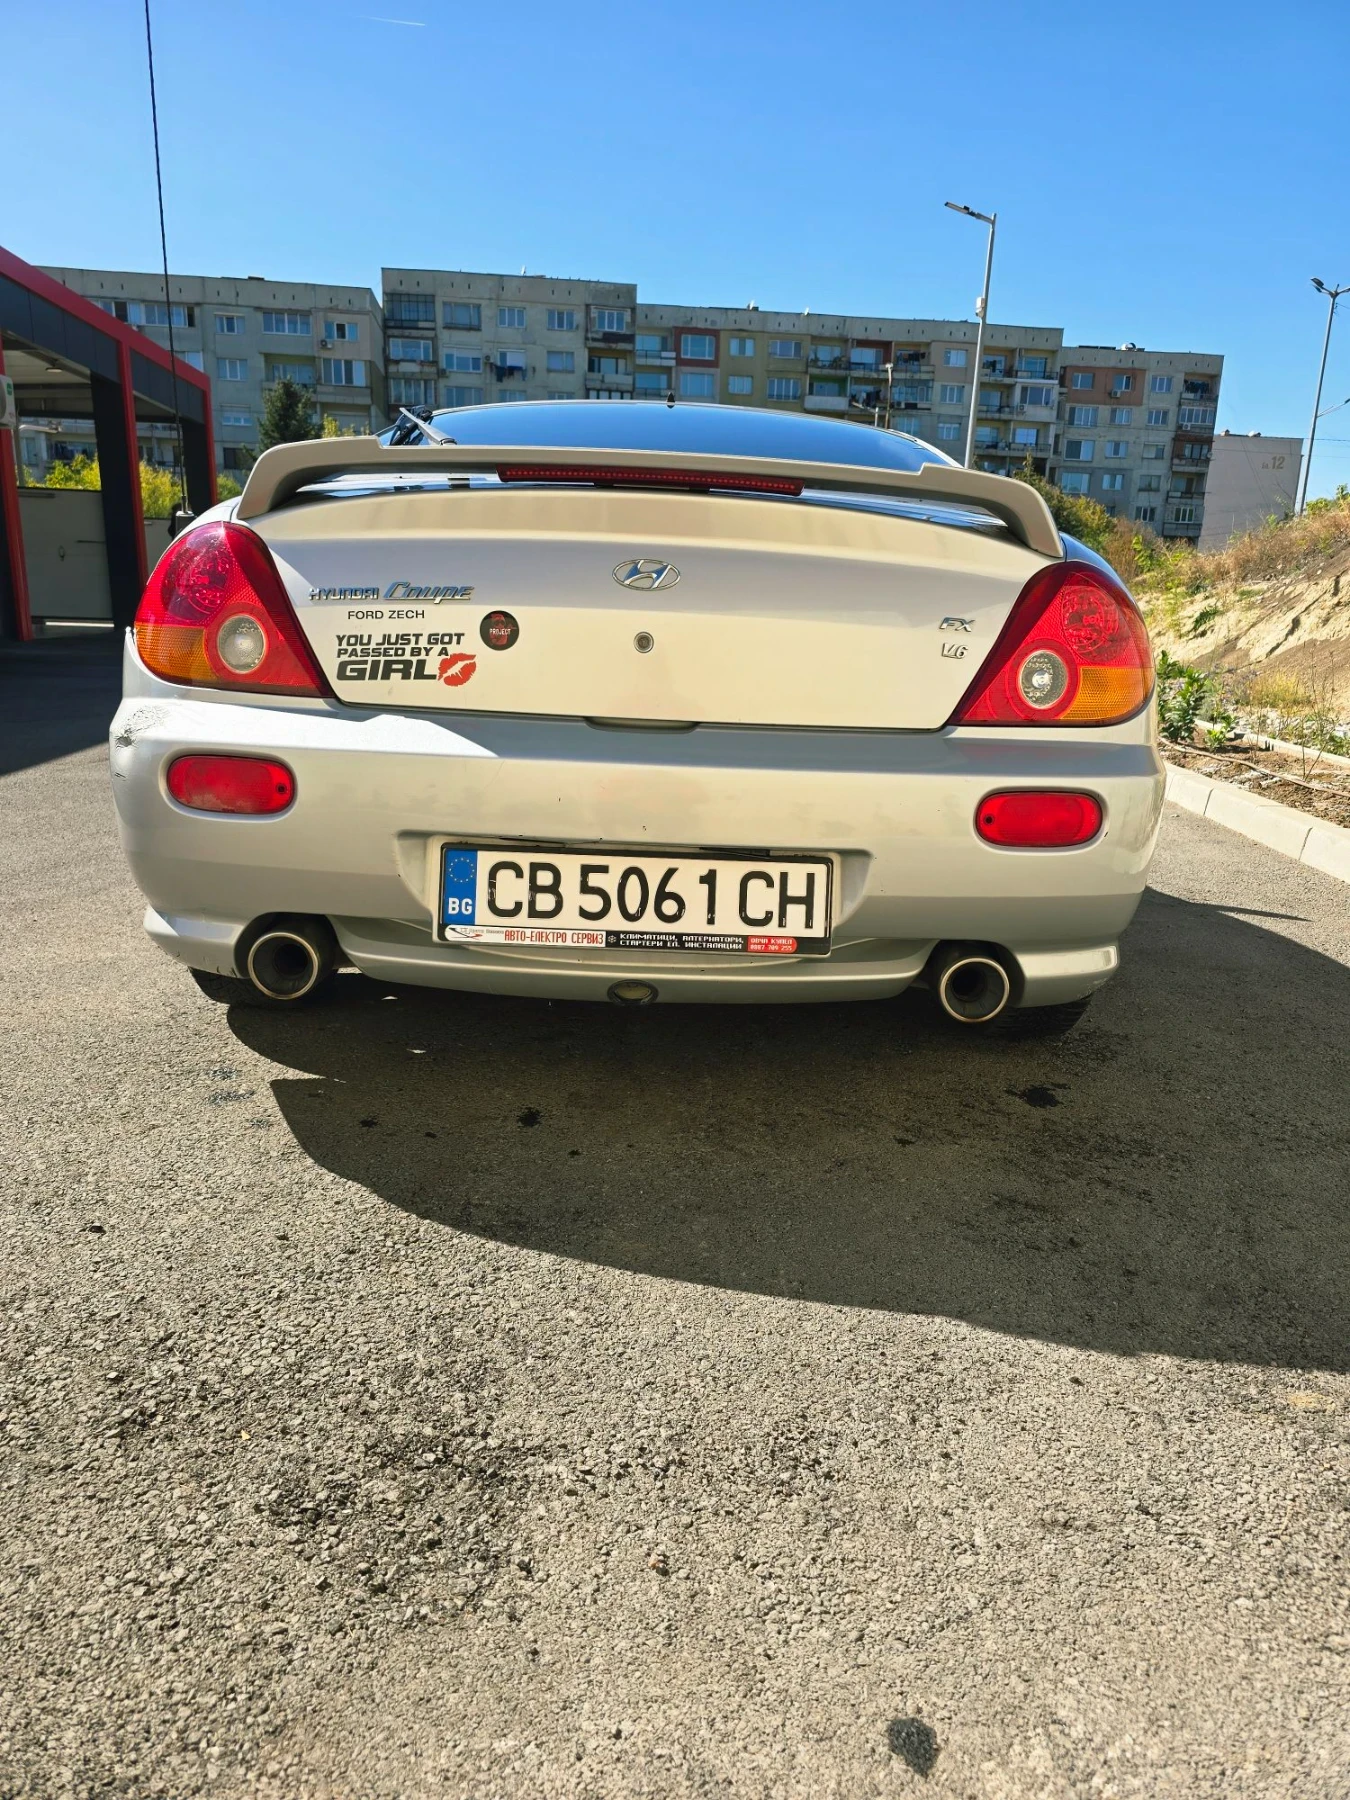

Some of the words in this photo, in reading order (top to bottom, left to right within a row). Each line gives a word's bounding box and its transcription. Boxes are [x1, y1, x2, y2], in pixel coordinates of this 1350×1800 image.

[1271, 455, 1286, 470] 12
[309, 587, 379, 600] HYUNDAI
[384, 581, 475, 604] Coupe
[347, 610, 384, 620] FORD
[388, 609, 425, 619] ZECH
[939, 616, 976, 632] FX
[336, 634, 372, 647] YOU
[375, 633, 423, 646] JUST
[427, 632, 465, 645] GOT
[337, 647, 405, 658] PASSED
[410, 646, 436, 657] BY
[437, 646, 449, 657] A
[941, 642, 969, 660] V6
[336, 659, 437, 681] GIRL
[487, 861, 563, 918] CB
[579, 864, 717, 925] 5061
[739, 871, 815, 928] CH
[448, 897, 473, 914] BG
[504, 929, 567, 943] АВТО-ЕЛЕКТРО
[571, 931, 604, 945] СЕРВИЗ
[620, 933, 678, 941] КЛИМАТИЦИ,
